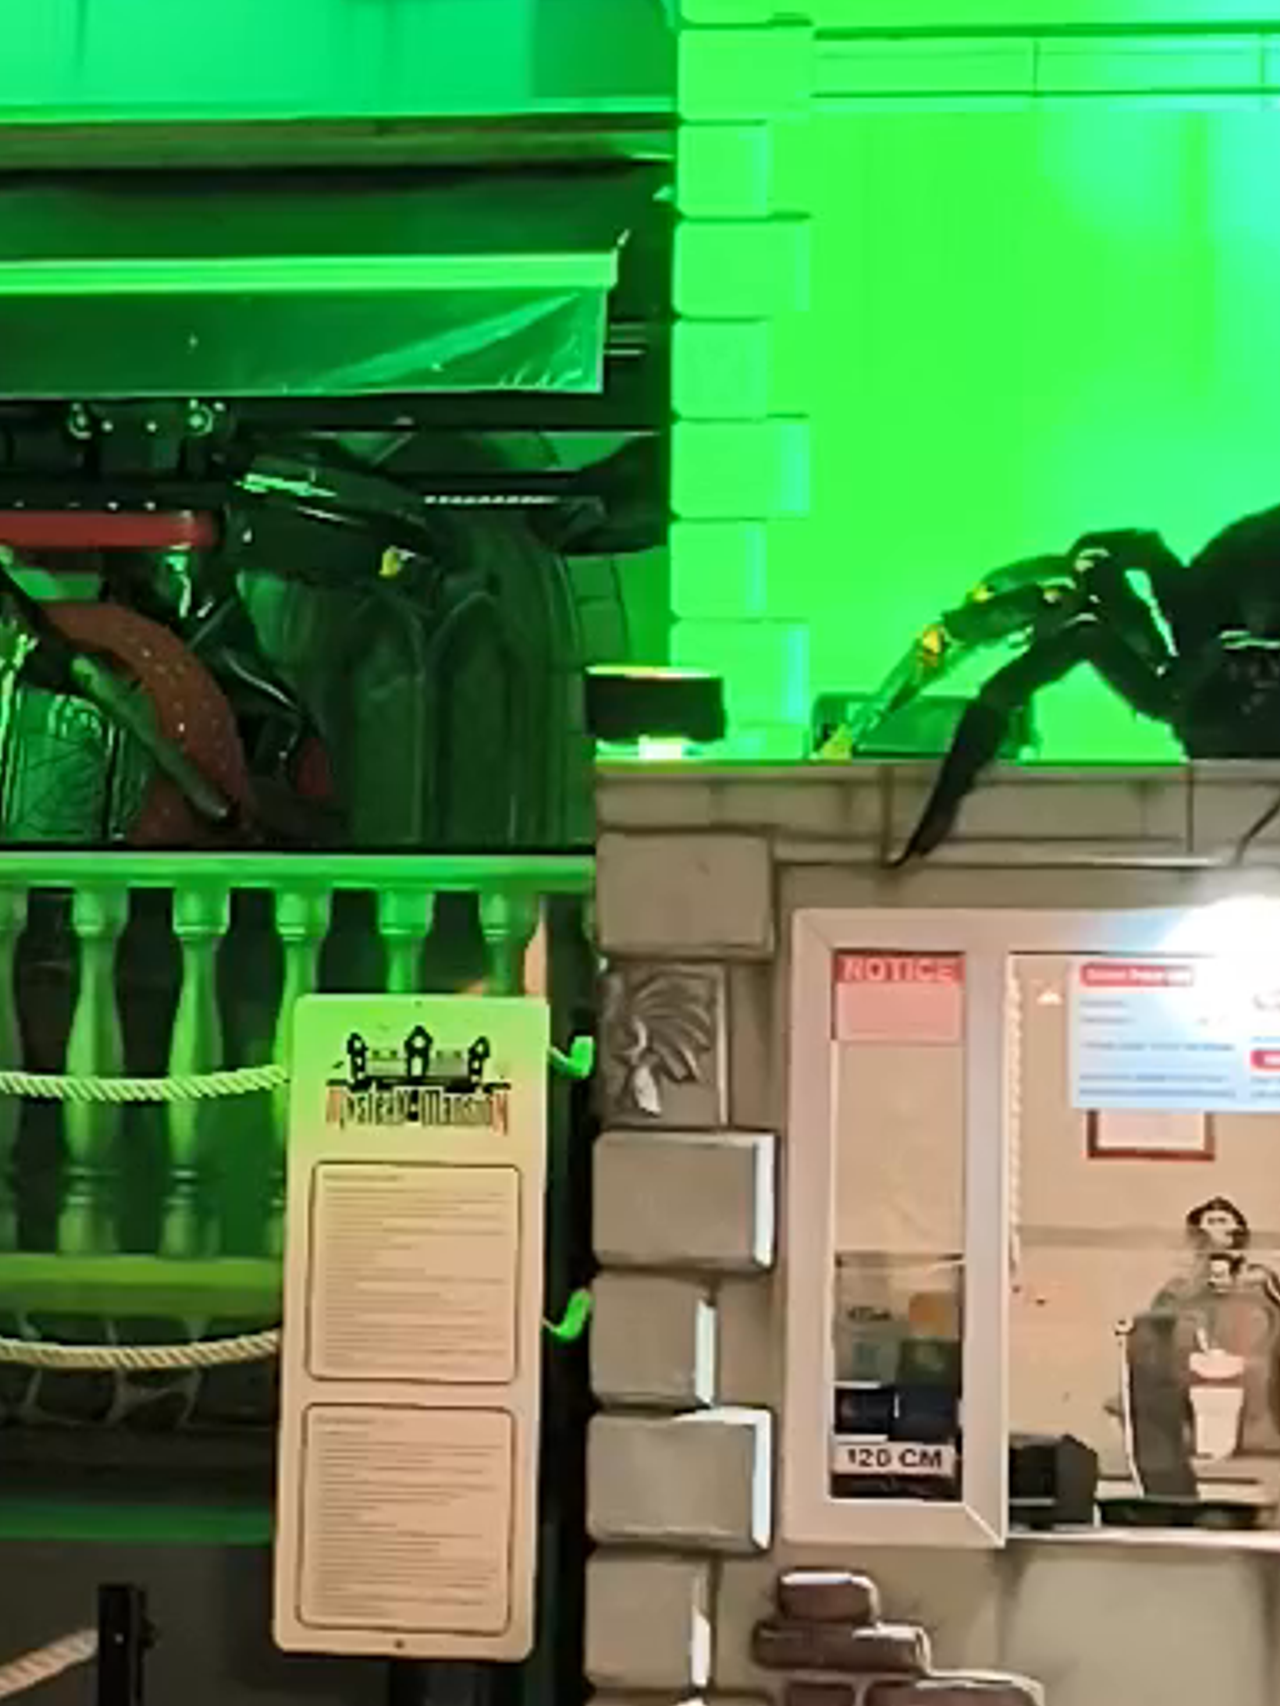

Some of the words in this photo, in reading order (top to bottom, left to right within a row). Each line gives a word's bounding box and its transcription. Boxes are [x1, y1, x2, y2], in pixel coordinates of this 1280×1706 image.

[842, 957, 956, 984] NOTICE
[847, 1448, 892, 1468] 120
[899, 1448, 942, 1469] CM
